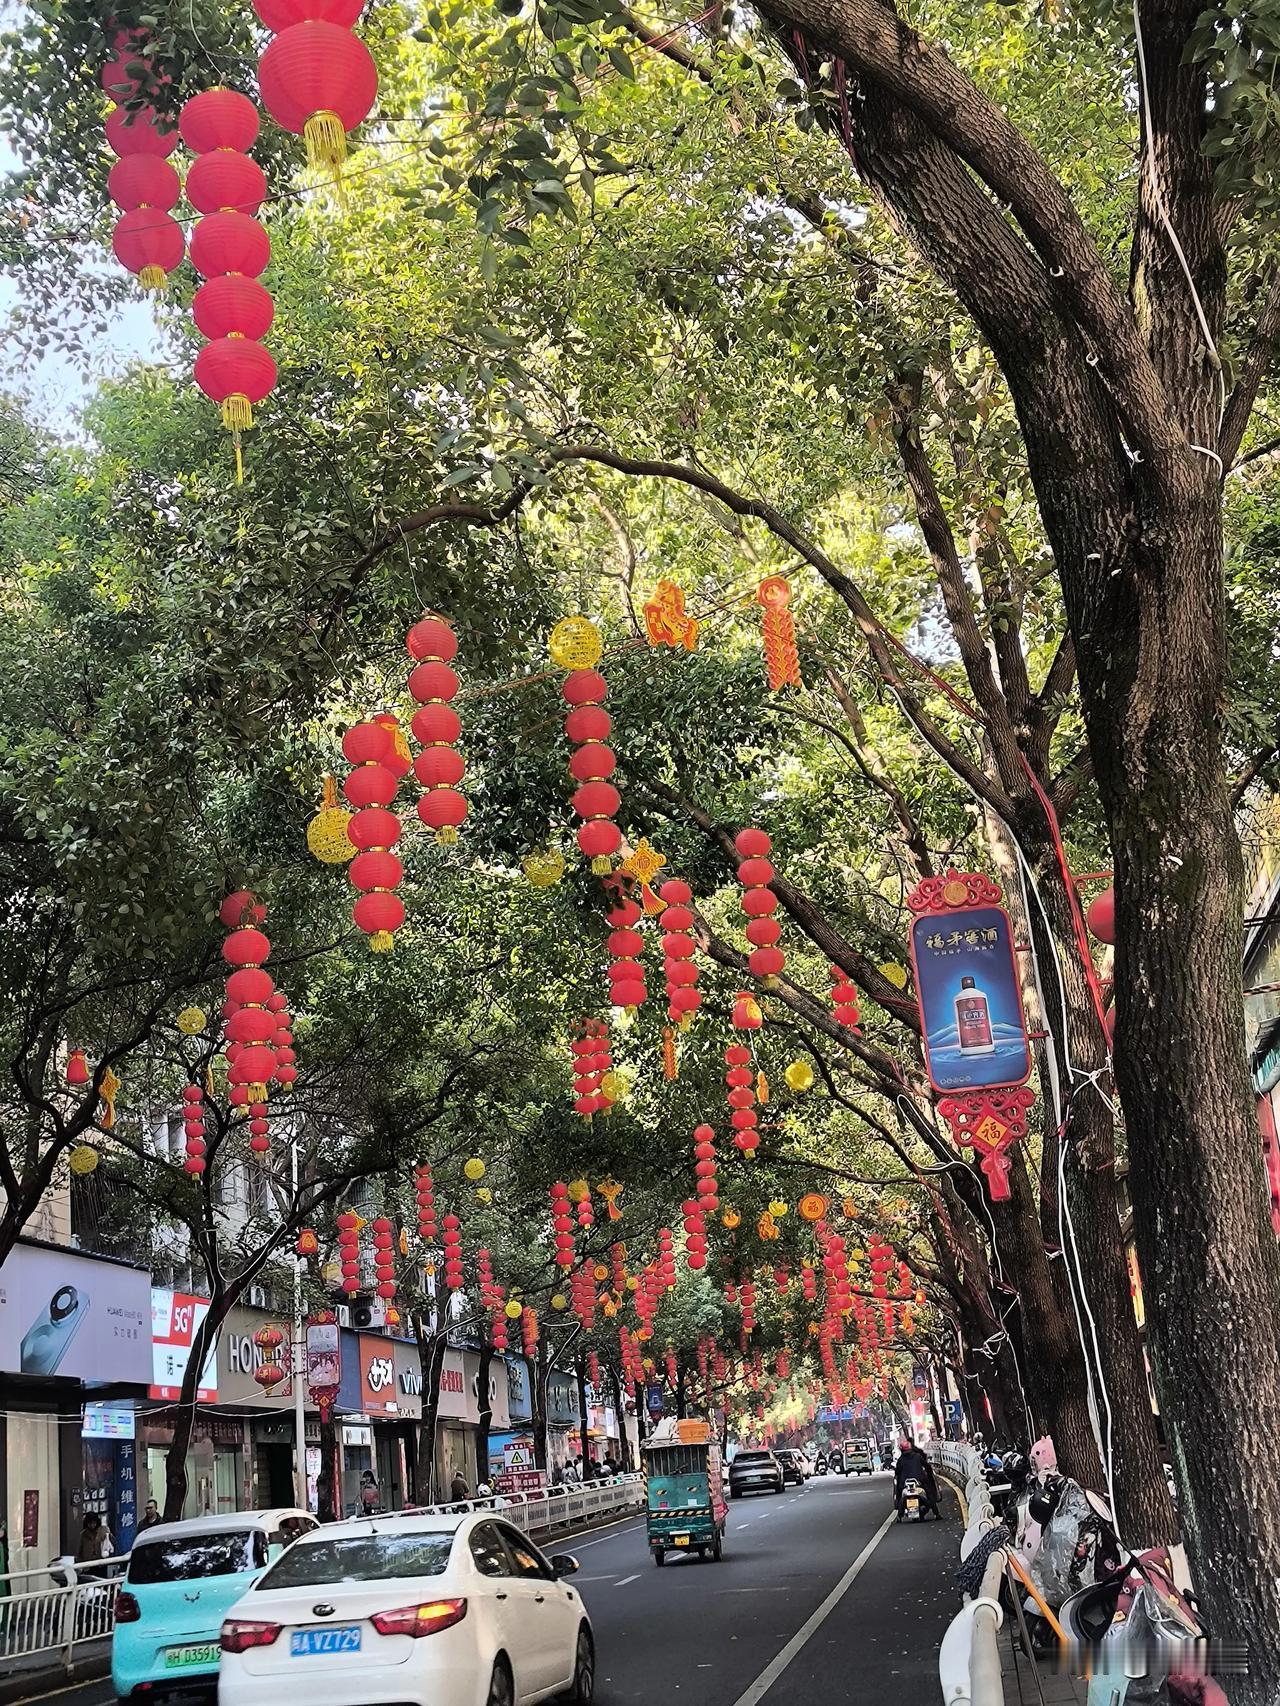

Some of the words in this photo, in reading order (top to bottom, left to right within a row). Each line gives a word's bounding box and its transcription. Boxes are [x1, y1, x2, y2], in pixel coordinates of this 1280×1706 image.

[981, 1121, 1001, 1141] 福
[945, 1404, 956, 1421] P
[120, 1444, 134, 1527] 手机维修
